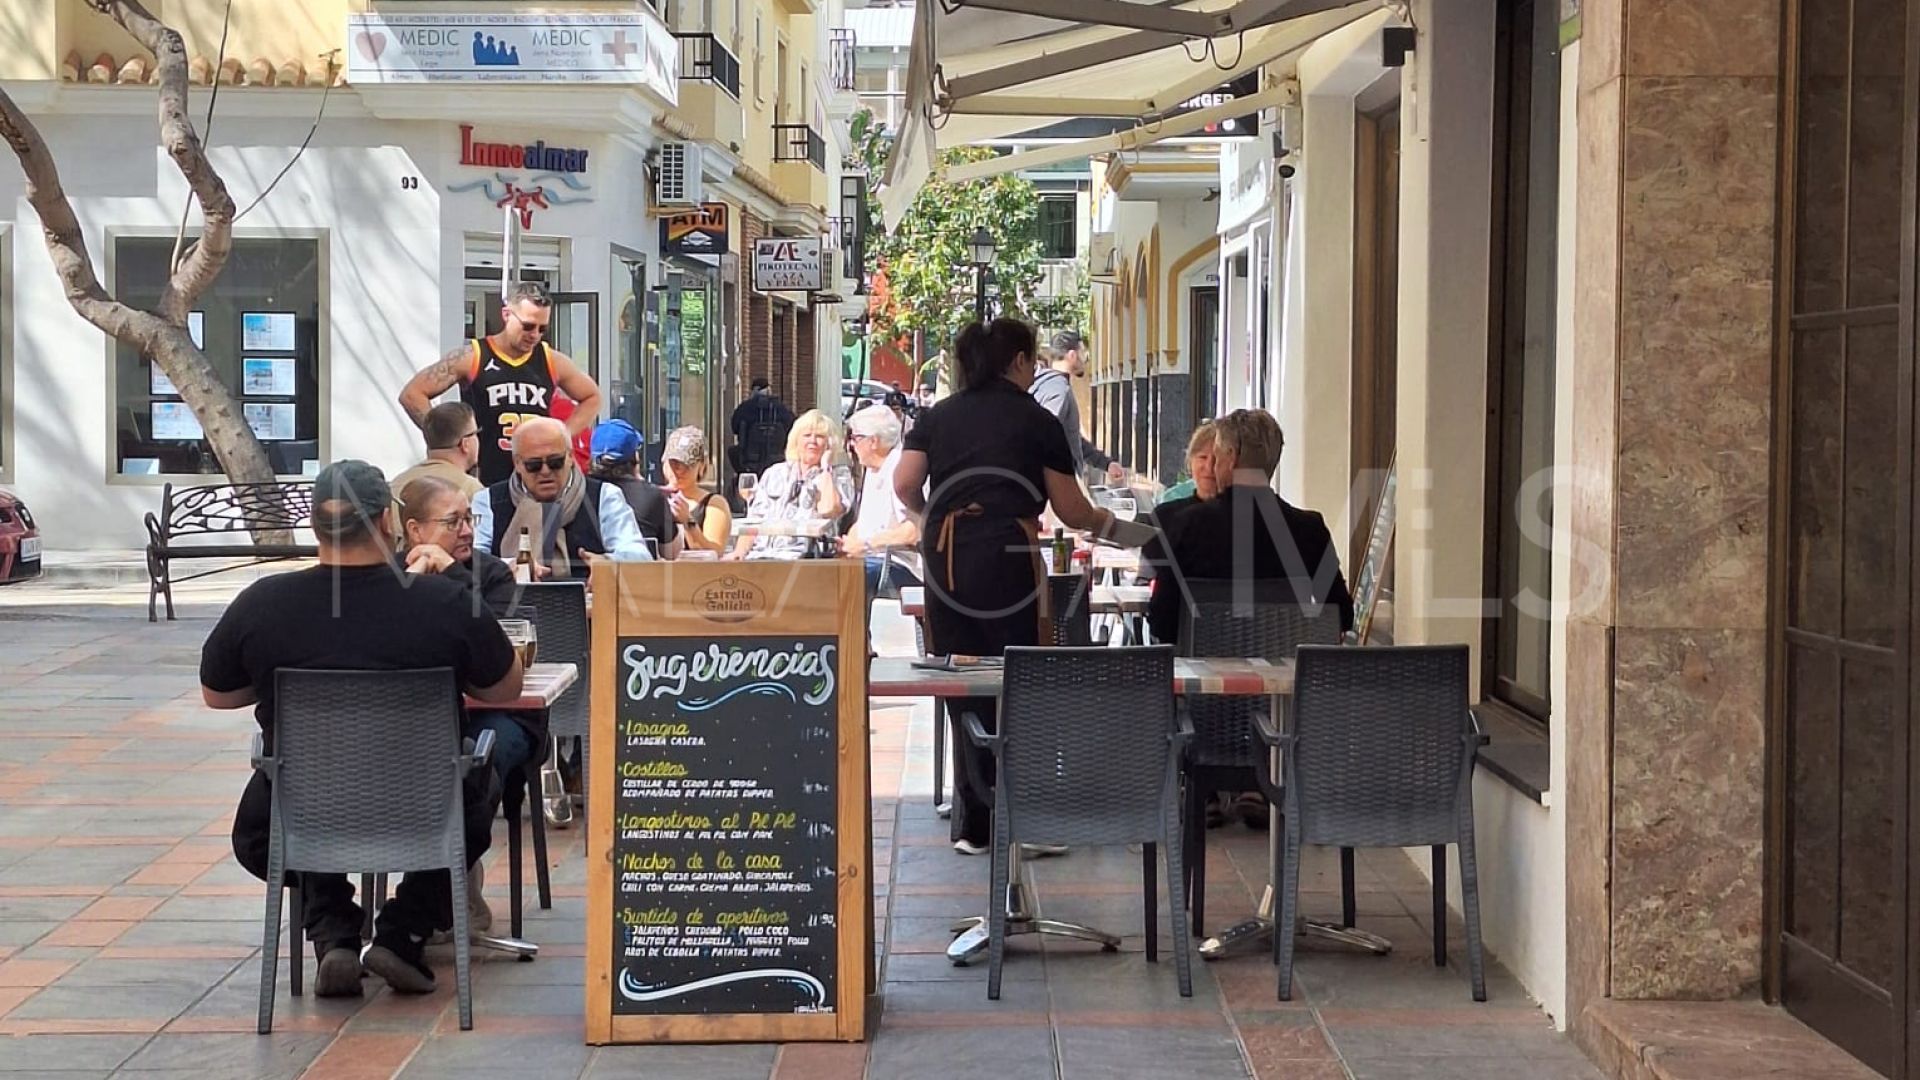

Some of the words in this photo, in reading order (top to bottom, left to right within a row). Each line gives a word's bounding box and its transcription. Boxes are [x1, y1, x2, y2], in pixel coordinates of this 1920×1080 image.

[400, 29, 460, 46] MEDIC
[531, 29, 592, 46] MEDIC
[459, 124, 589, 173] Inmoalmar
[401, 177, 418, 190] 93
[773, 271, 804, 281] CAZA
[486, 382, 548, 410] PHX
[705, 588, 754, 600] Estrella
[705, 600, 752, 612] Galicia
[623, 642, 837, 706] Sugerencias
[626, 719, 690, 737] Lasagna
[623, 761, 689, 777] Costillas
[622, 810, 712, 830] Langostinos
[721, 812, 740, 829] al
[623, 852, 676, 870] Nachos
[686, 852, 704, 869] de
[716, 851, 736, 869] la
[745, 854, 782, 869] casa
[623, 907, 677, 924] Surtido
[686, 907, 704, 924] de
[766, 926, 789, 936] COCO
